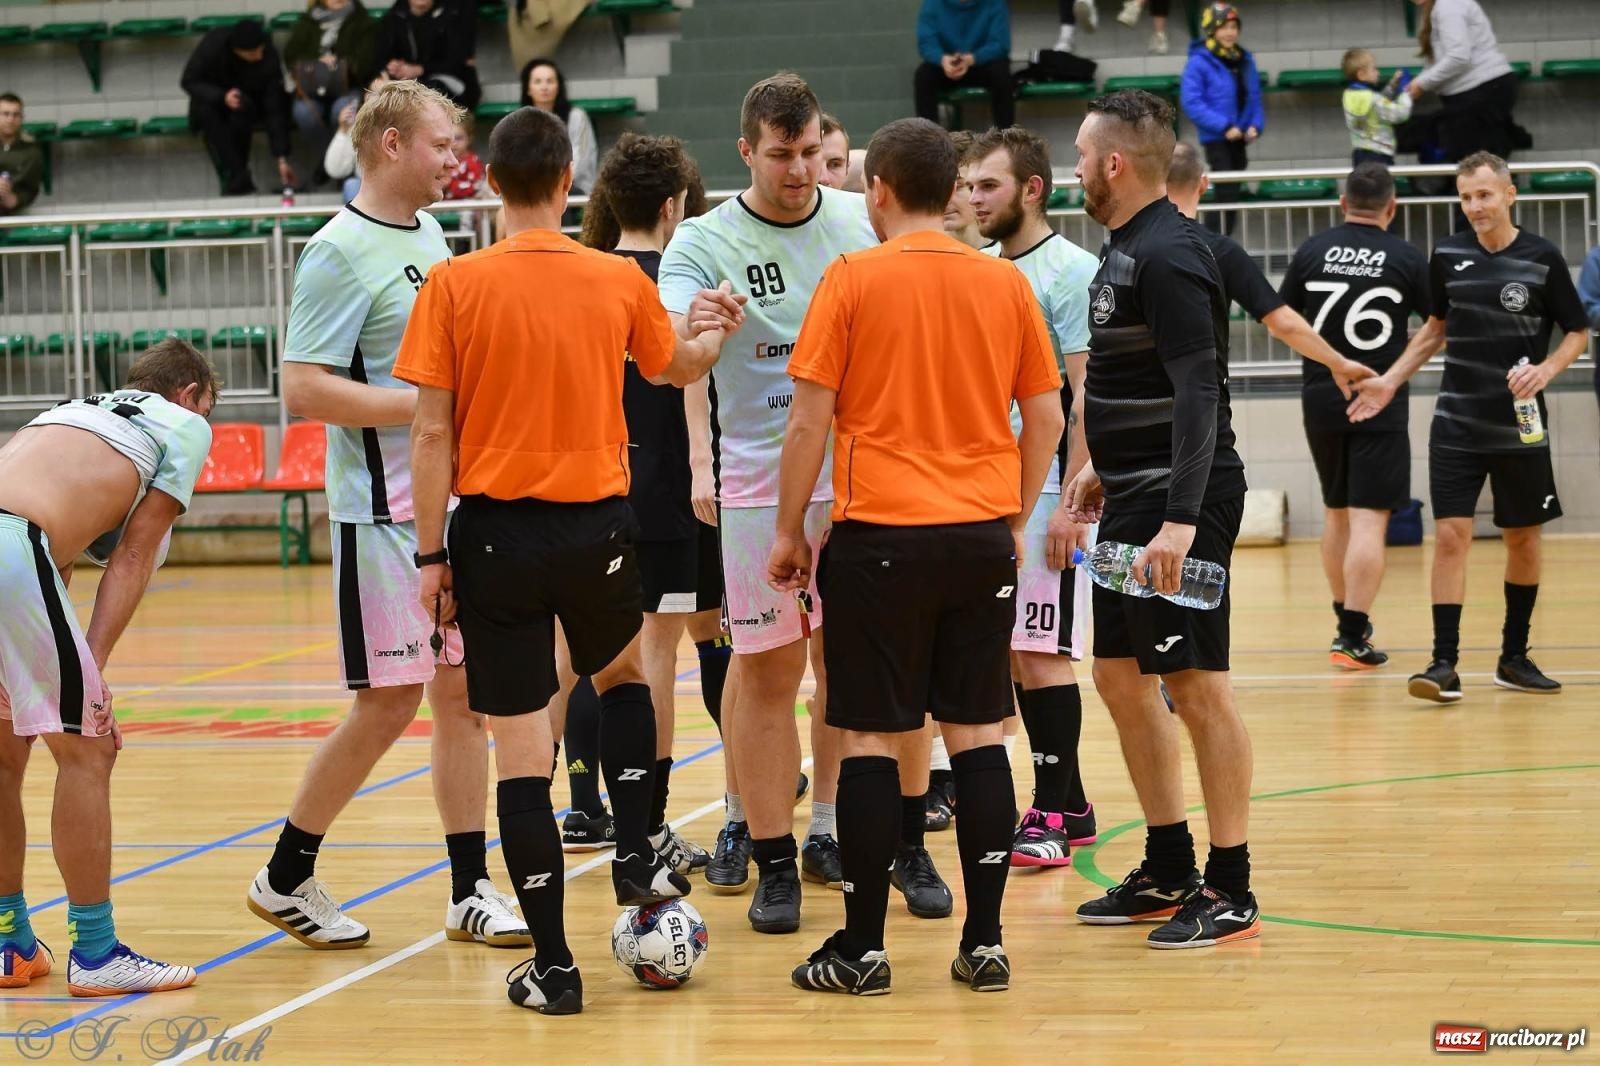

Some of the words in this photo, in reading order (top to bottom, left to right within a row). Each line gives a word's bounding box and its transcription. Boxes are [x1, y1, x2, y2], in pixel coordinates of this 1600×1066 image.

[1322, 263, 1384, 278] RACIBÓRZ
[1324, 246, 1387, 267] ODRA
[747, 262, 786, 298] 99
[1305, 281, 1404, 351] 76
[1025, 602, 1055, 632] 20
[667, 916, 687, 967] SELECT
